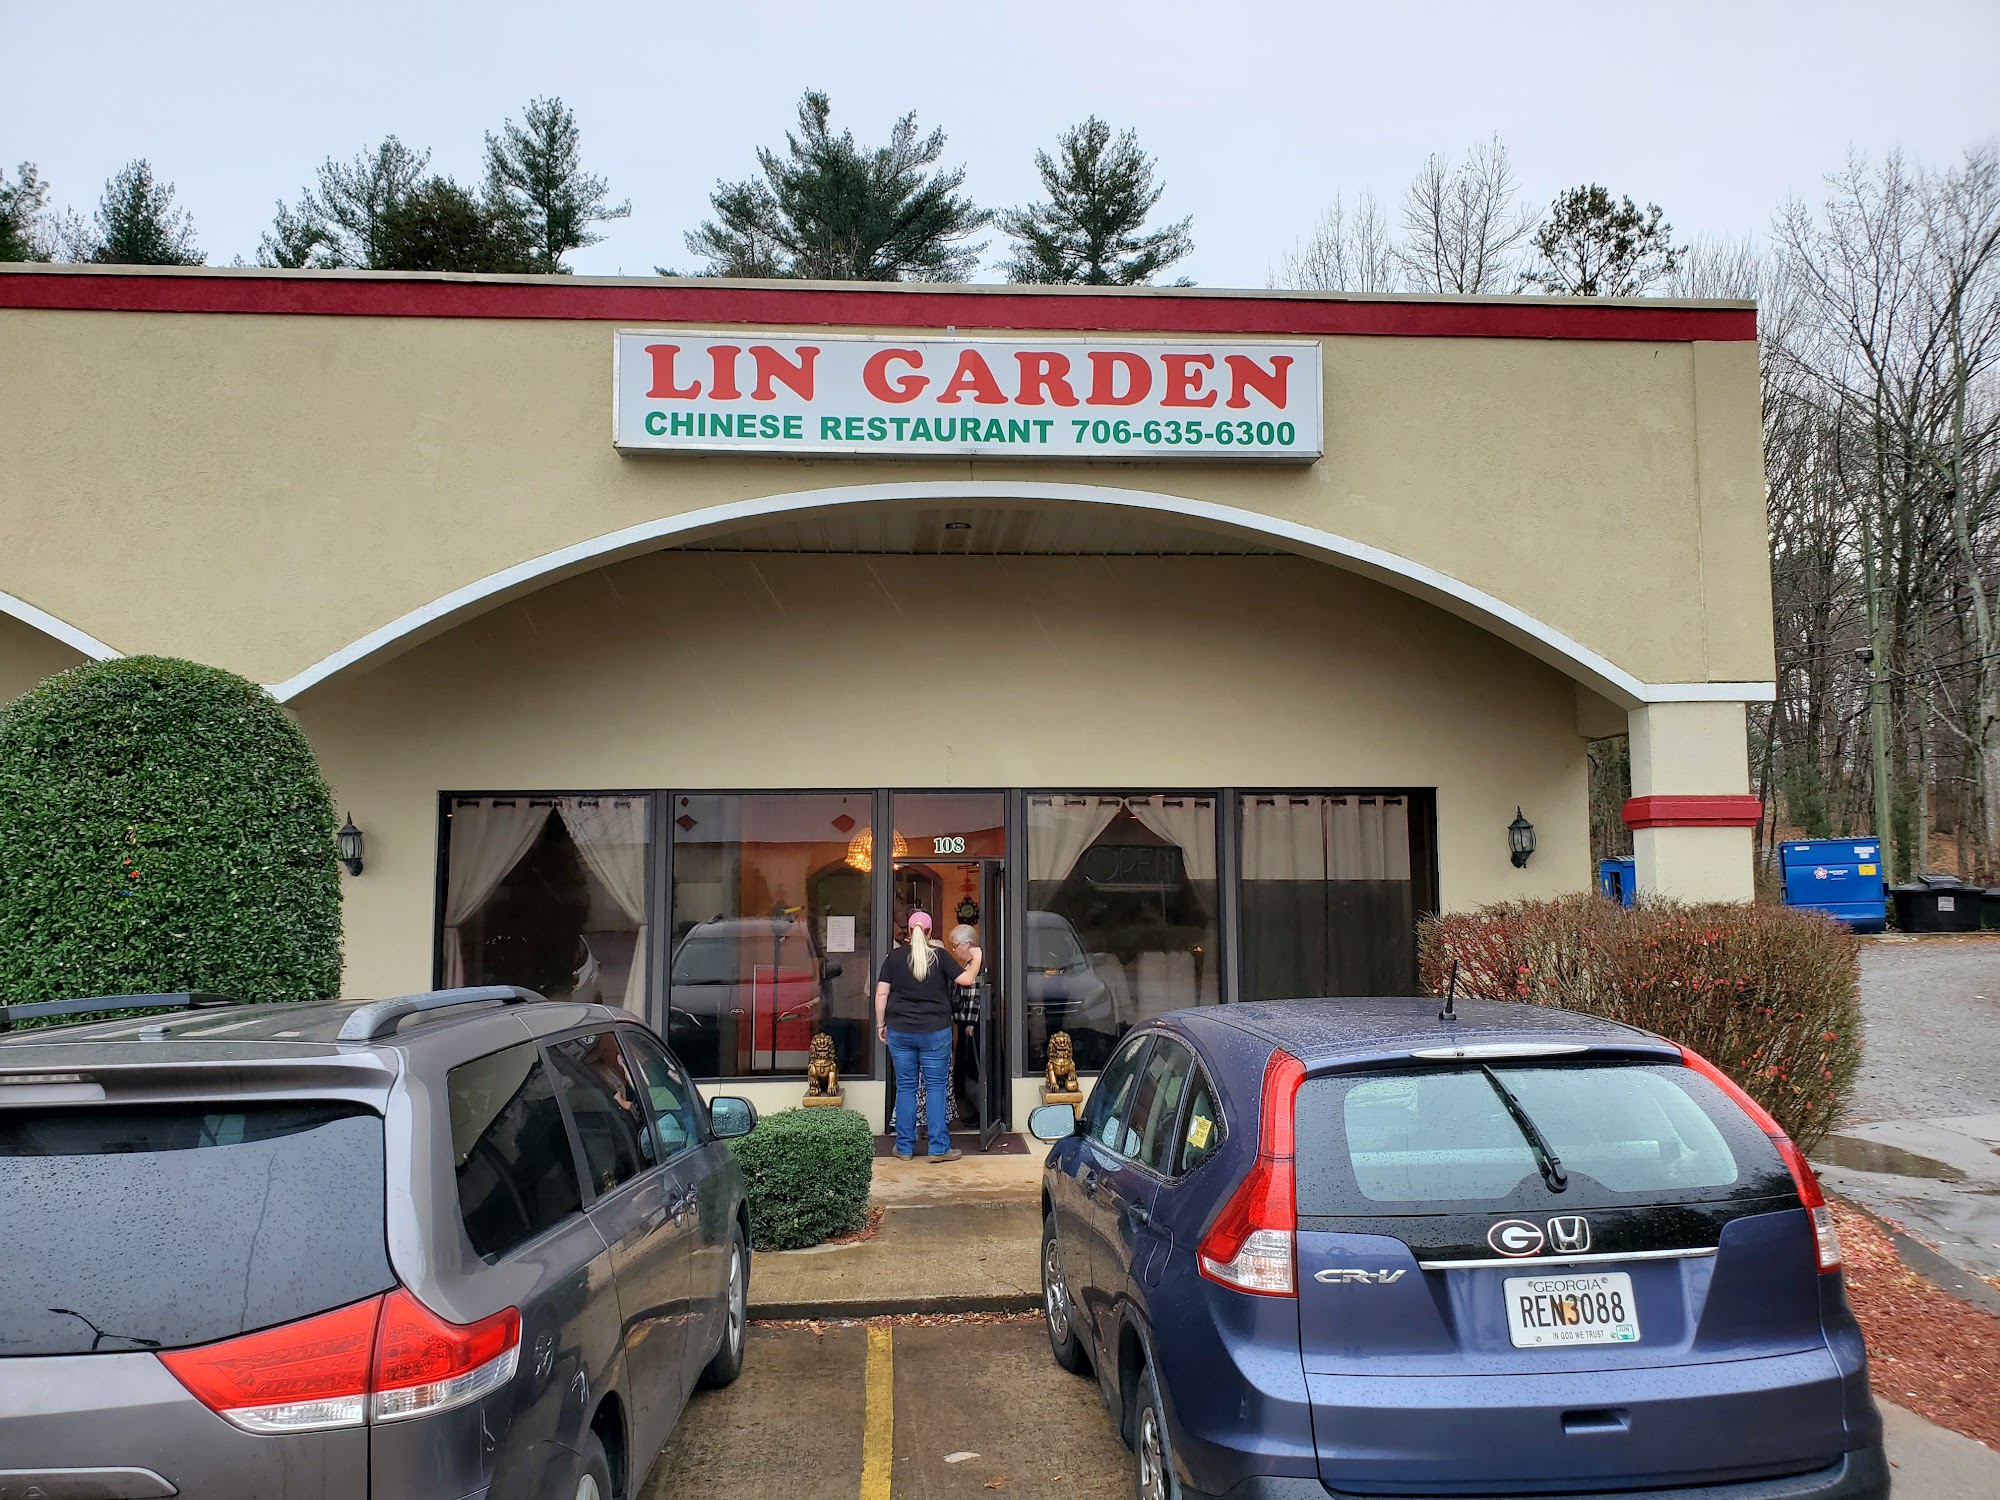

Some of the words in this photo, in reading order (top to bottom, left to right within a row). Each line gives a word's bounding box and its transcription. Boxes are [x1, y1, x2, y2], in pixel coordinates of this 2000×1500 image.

[644, 344, 821, 401] LIN
[863, 348, 1293, 409] GARDEN
[645, 411, 803, 439] CHINESE
[820, 416, 1054, 444] RESTAURANT
[1072, 419, 1295, 446] 706-635-6300
[933, 836, 966, 855] 108
[1084, 847, 1175, 881] OPEN
[1313, 1269, 1407, 1284] CR-V
[1533, 1279, 1602, 1293] GEORGIA
[1519, 1291, 1625, 1328] REN3088
[1561, 1331, 1574, 1339] GOD
[1575, 1330, 1584, 1339] WE
[1586, 1329, 1604, 1339] TRUST
